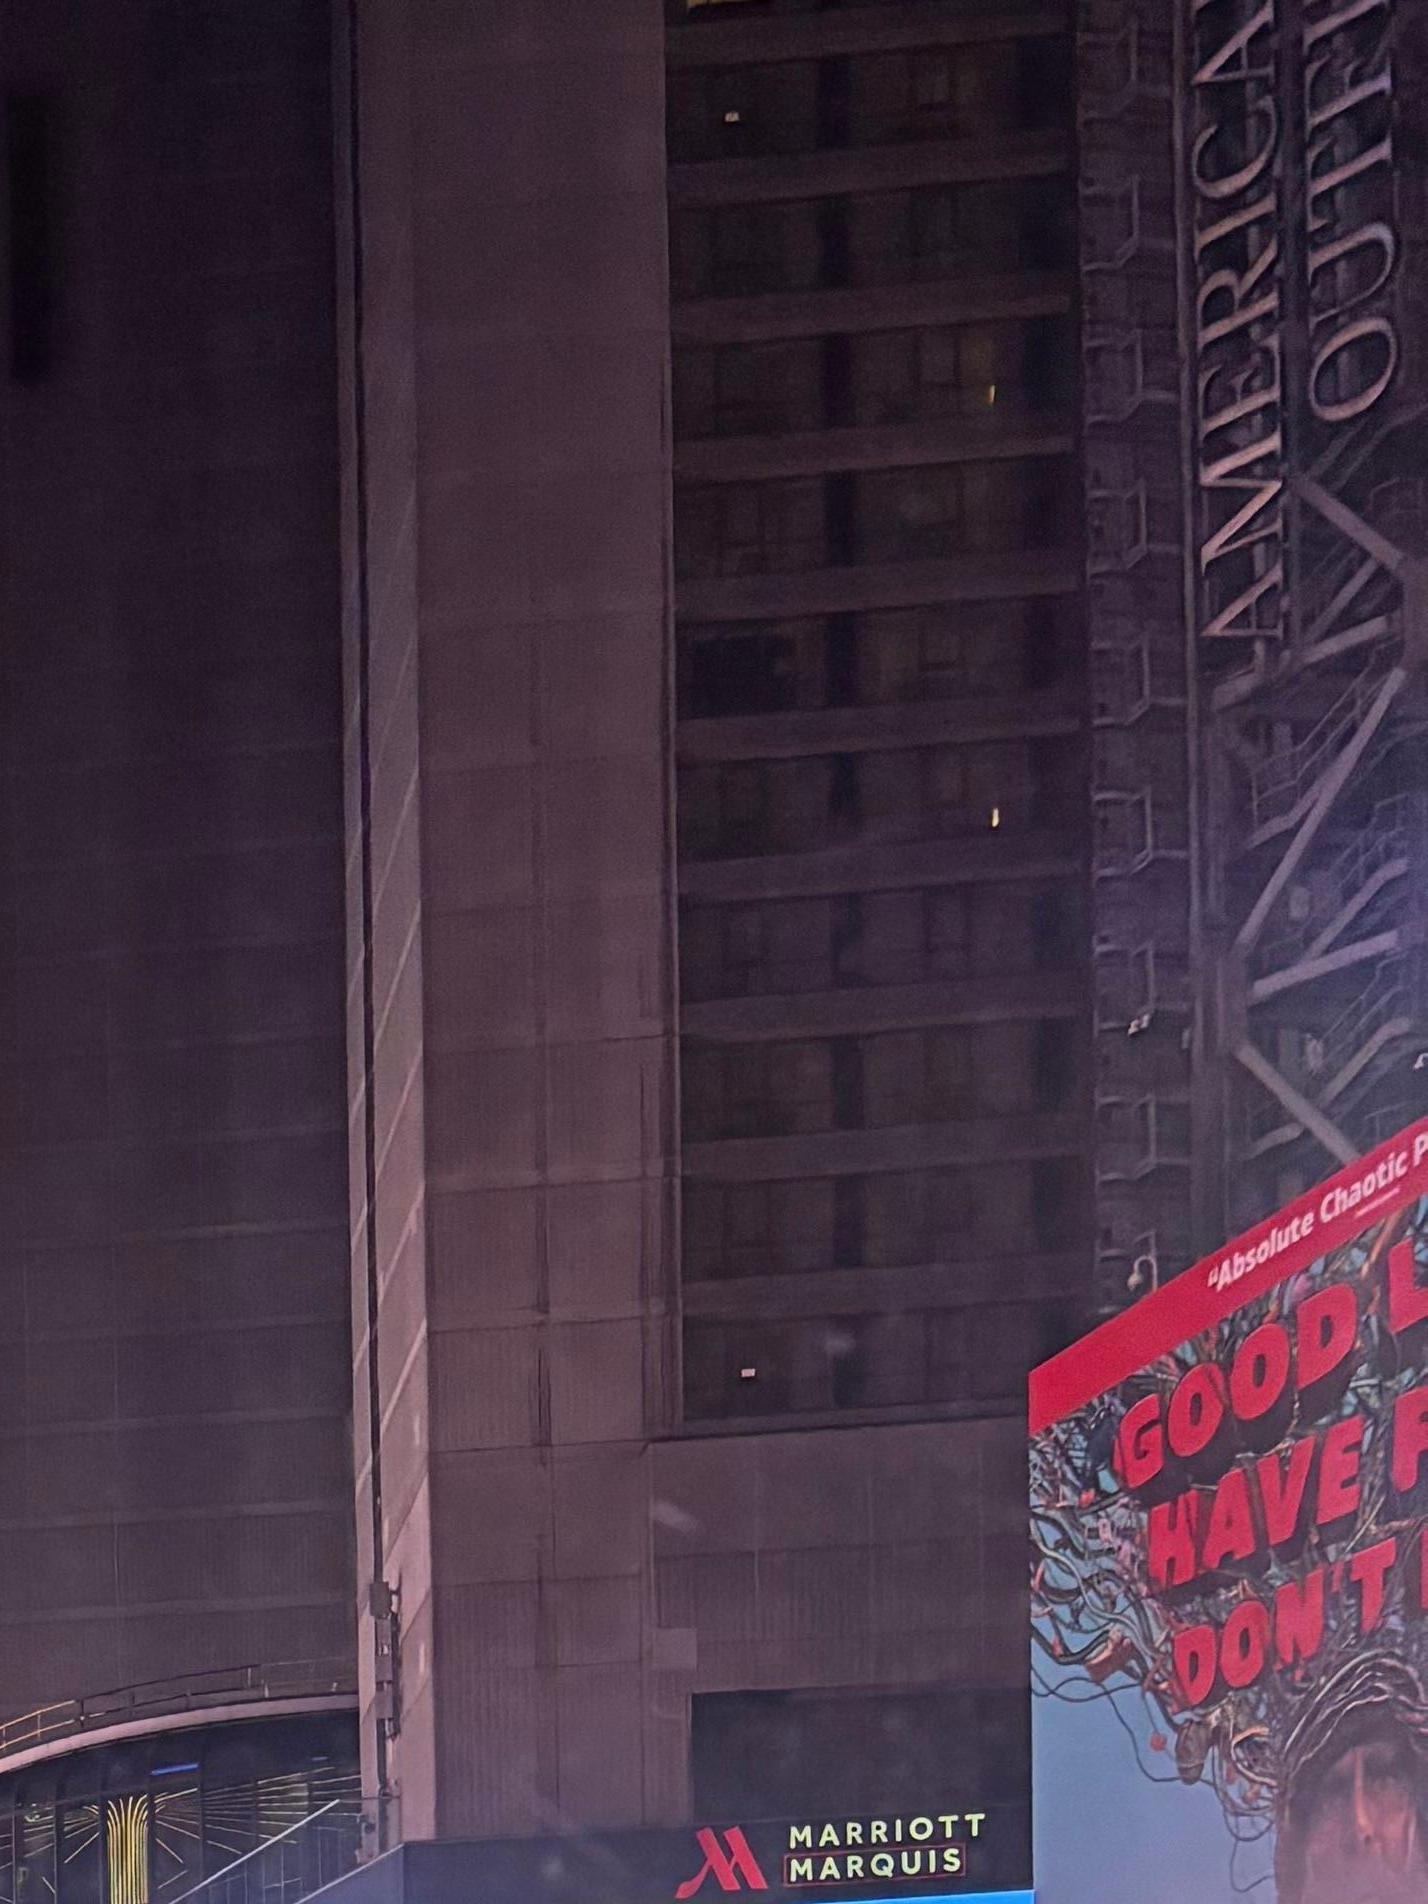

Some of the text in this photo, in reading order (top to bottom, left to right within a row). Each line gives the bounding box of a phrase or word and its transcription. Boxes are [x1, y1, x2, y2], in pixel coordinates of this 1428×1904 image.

[1319, 1153, 1409, 1225] Chaotic
[1114, 1284, 1357, 1488] GOOD
[1148, 1414, 1364, 1586] HAVE
[1173, 1537, 1397, 1709] DON'T
[789, 1812, 986, 1849] MARRIOTT
[789, 1848, 963, 1882] MARQUIS
